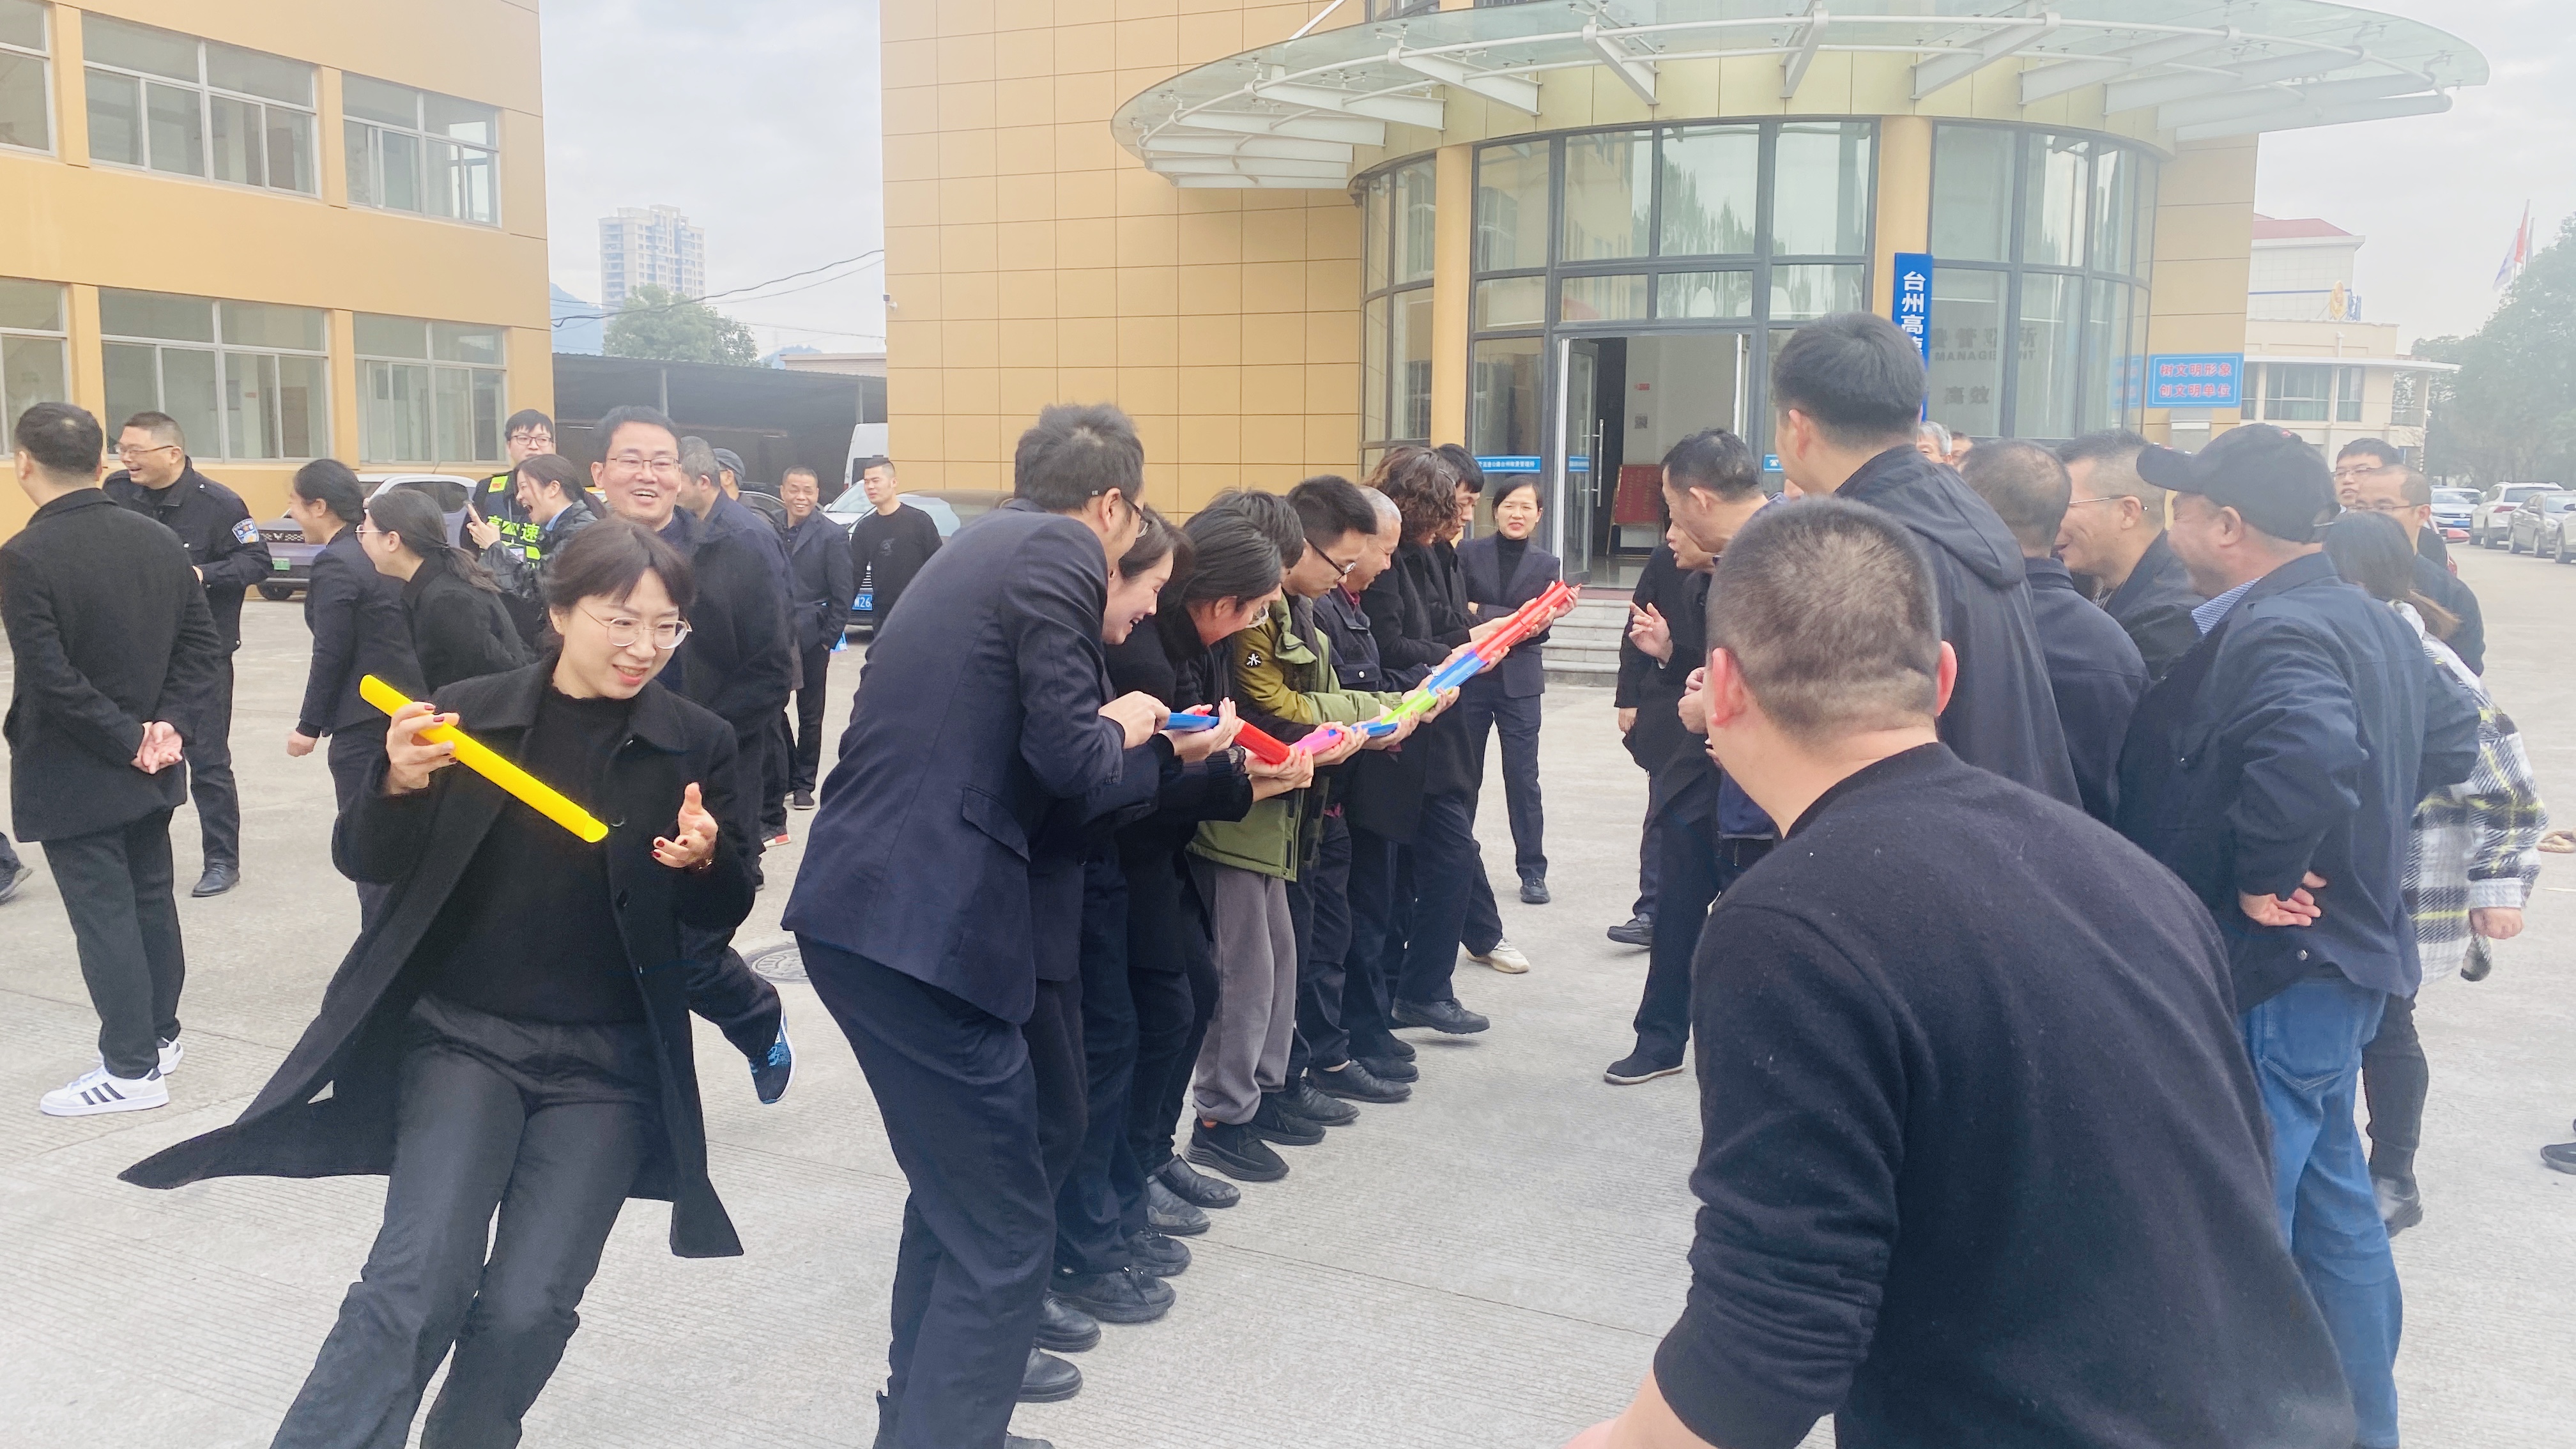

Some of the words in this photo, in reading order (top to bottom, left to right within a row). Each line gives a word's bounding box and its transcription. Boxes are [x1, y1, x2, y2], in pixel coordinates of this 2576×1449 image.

[2160, 363, 2232, 378] 树文明形象
[2159, 383, 2231, 398] 创文明单位
